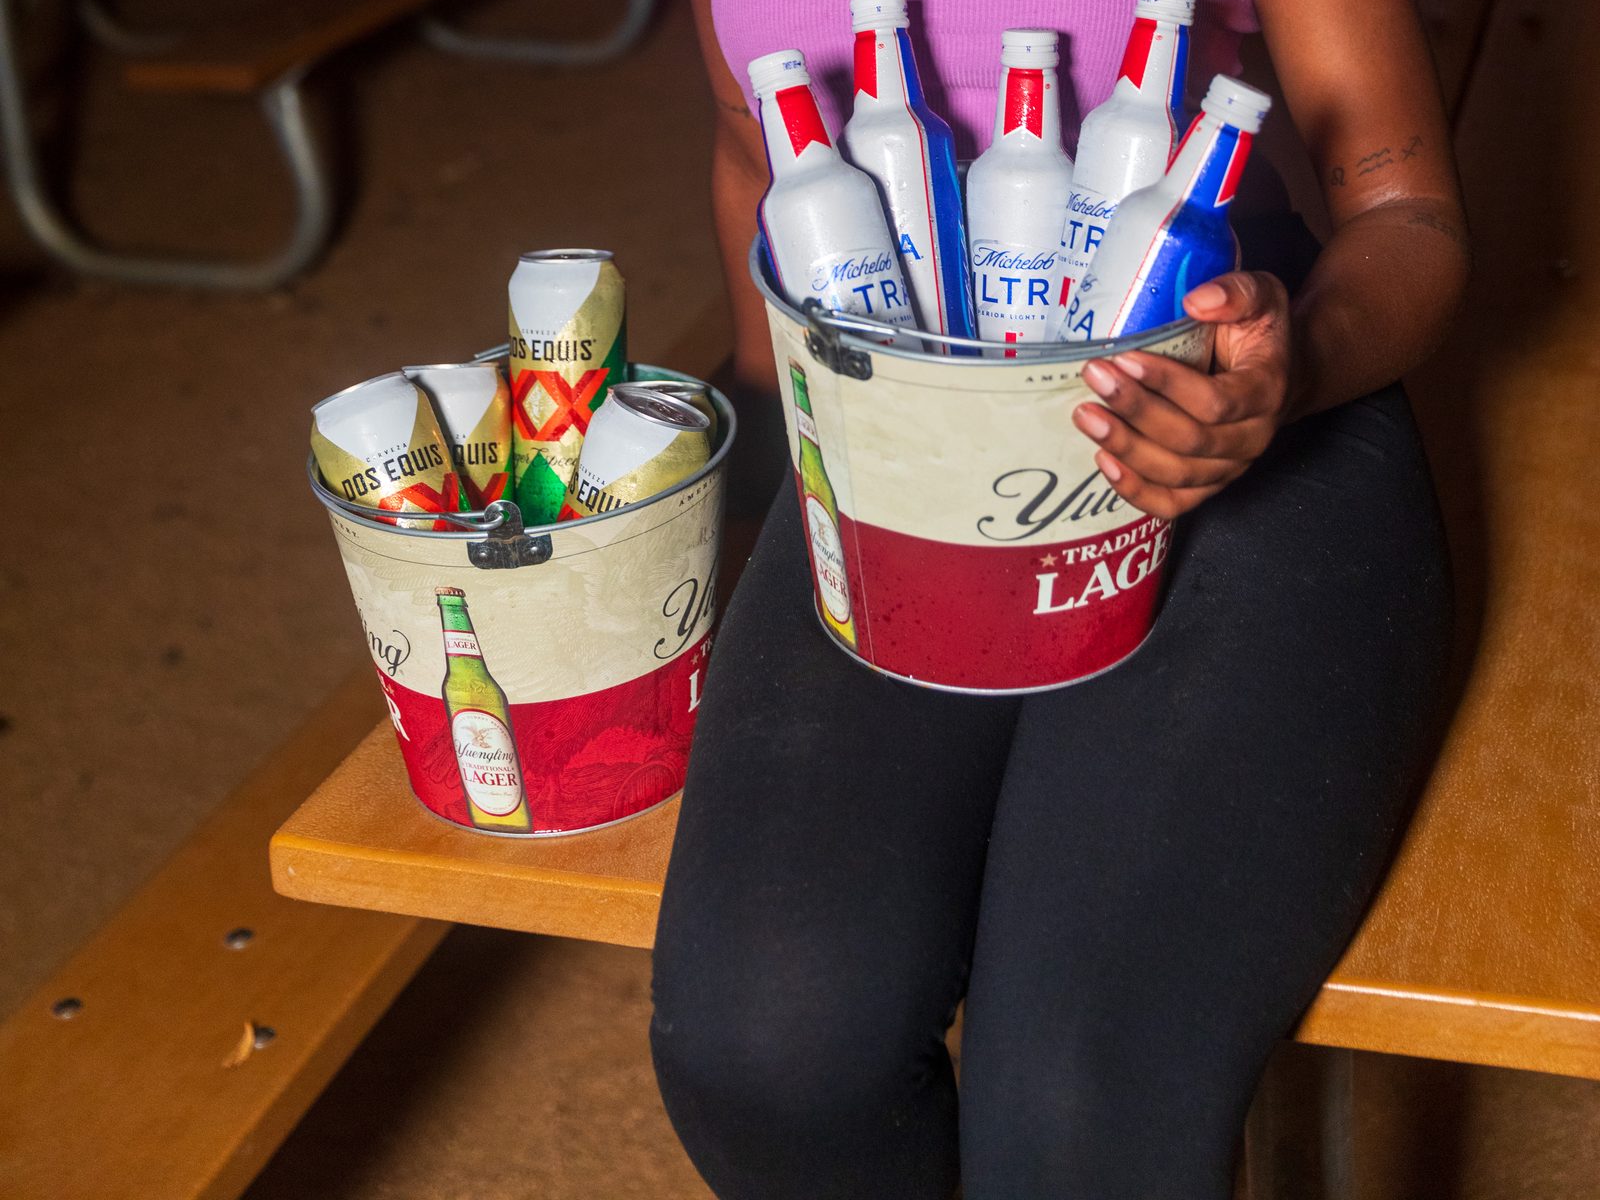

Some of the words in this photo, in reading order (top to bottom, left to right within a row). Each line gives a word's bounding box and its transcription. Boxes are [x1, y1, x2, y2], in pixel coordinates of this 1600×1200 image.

[973, 247, 1058, 271] Michelob
[811, 251, 892, 292] Michelob
[1009, 313, 1036, 321] LIGHT
[532, 340, 593, 363] EQUIS
[452, 442, 498, 467] QUIS
[342, 467, 381, 501] DOS
[384, 443, 444, 482] EQUIS
[577, 479, 630, 513] EQUI
[1033, 522, 1169, 615] LAGE
[447, 641, 477, 650] LAGER
[456, 741, 515, 764] Yuengling
[463, 768, 518, 787] LAGER
